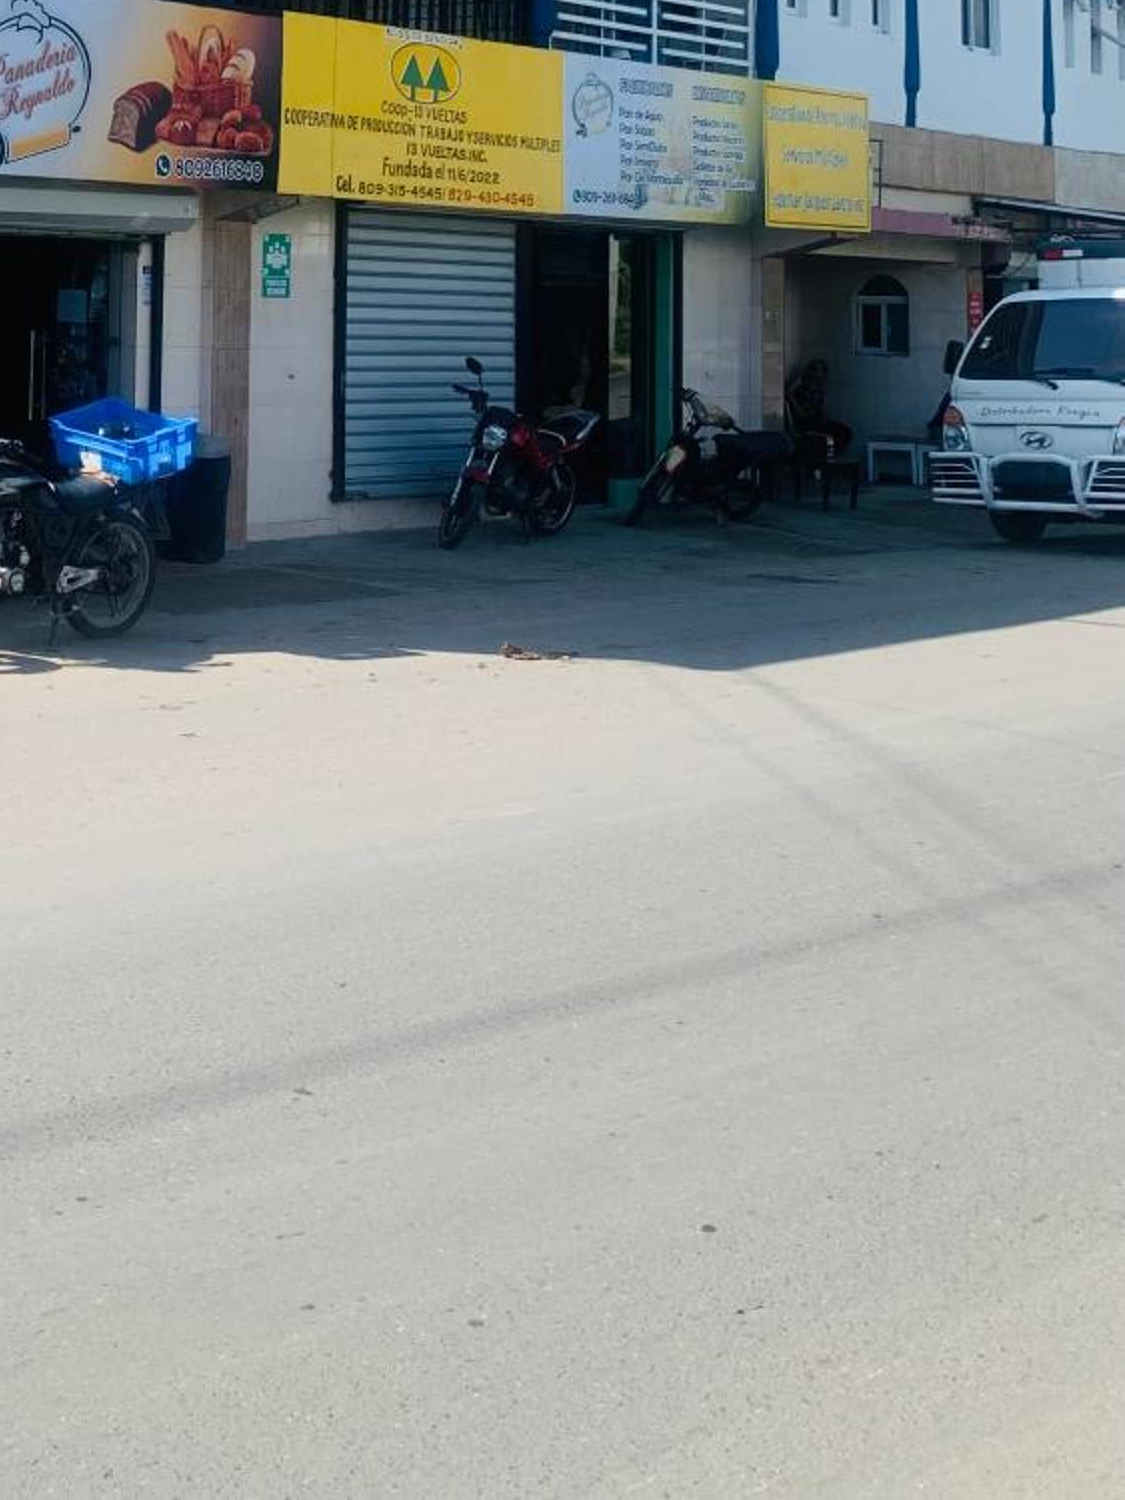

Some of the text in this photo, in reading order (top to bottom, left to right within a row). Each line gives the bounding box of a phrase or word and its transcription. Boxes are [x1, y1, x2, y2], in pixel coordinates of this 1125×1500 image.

[284, 107, 345, 130] COOPERATIVA
[347, 115, 359, 131] DE
[425, 105, 467, 125] VUELTAS
[406, 143, 418, 157] 13
[420, 144, 466, 161] VUELTAS
[382, 156, 432, 180] Fundada
[435, 162, 445, 180] el
[336, 174, 356, 194] Cel.
